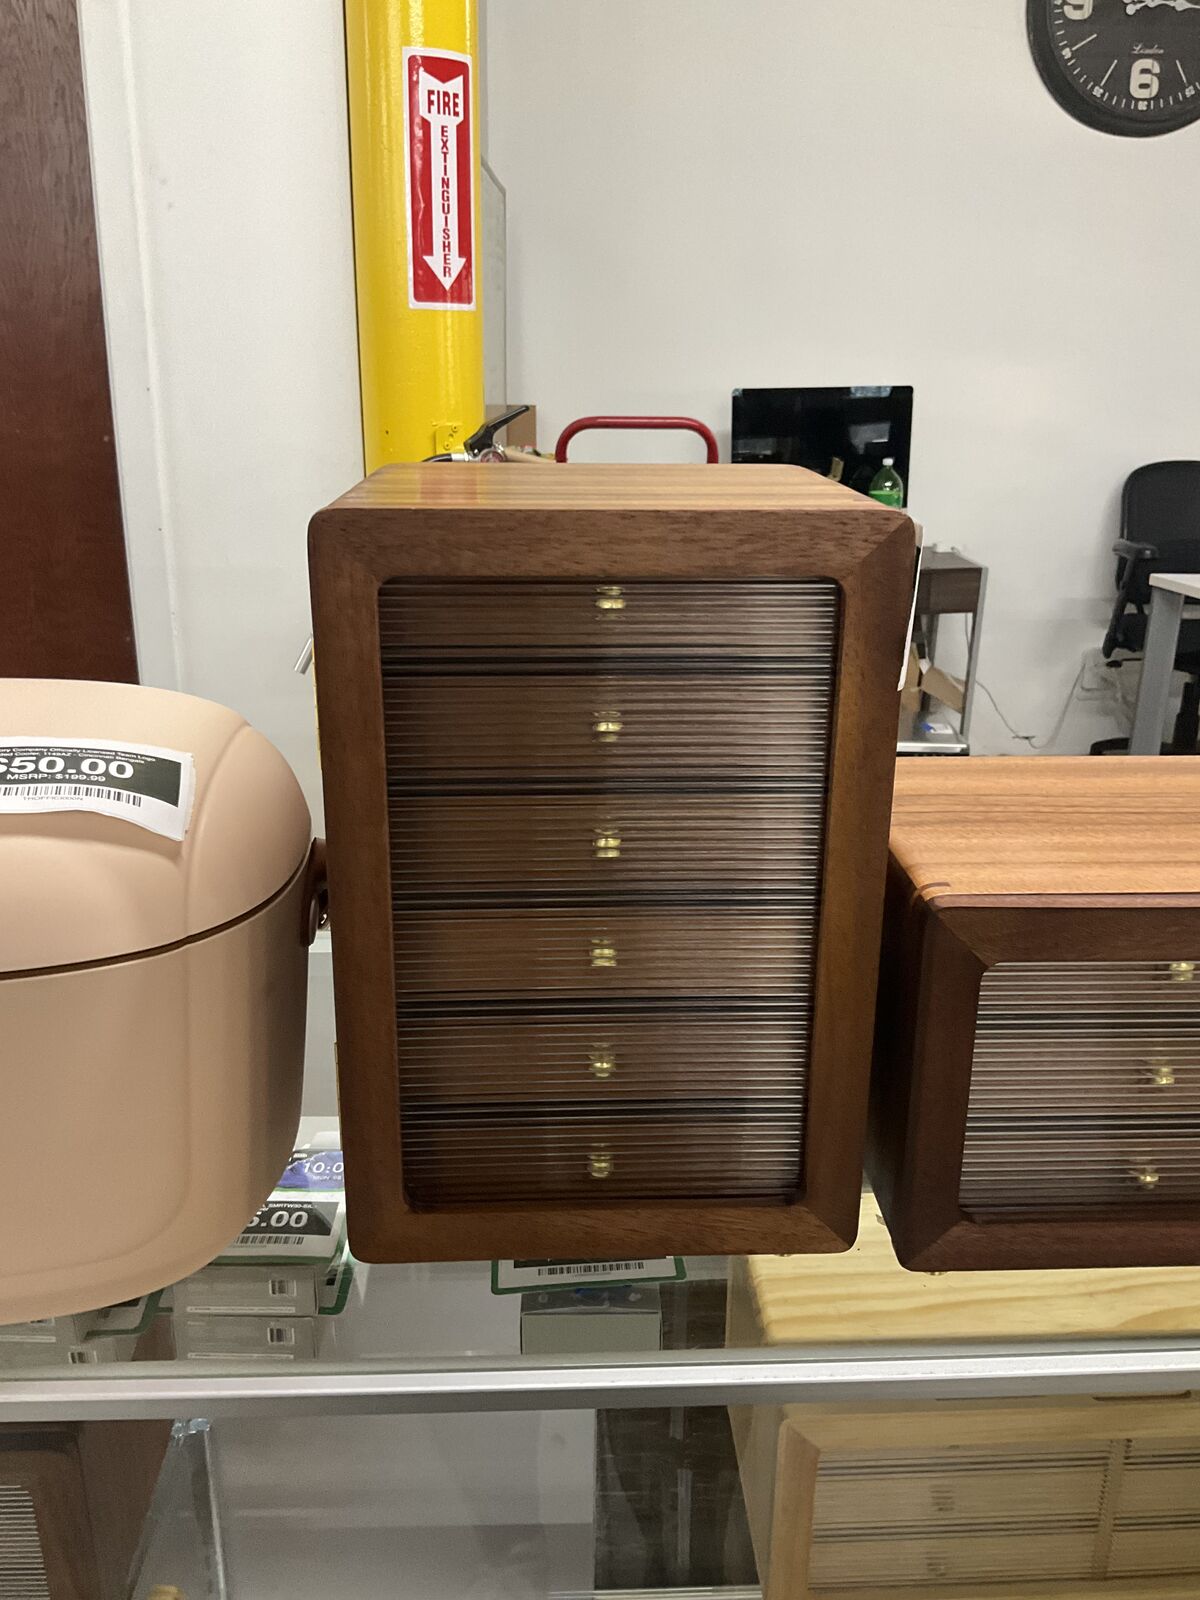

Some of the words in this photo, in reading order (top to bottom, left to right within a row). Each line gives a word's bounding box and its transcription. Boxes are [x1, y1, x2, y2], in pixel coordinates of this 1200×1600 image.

[1129, 58, 1161, 99] 6
[427, 89, 460, 117] FIRE
[440, 125, 452, 278] EXTINGUISHER
[54, 773, 106, 782] $199.99
